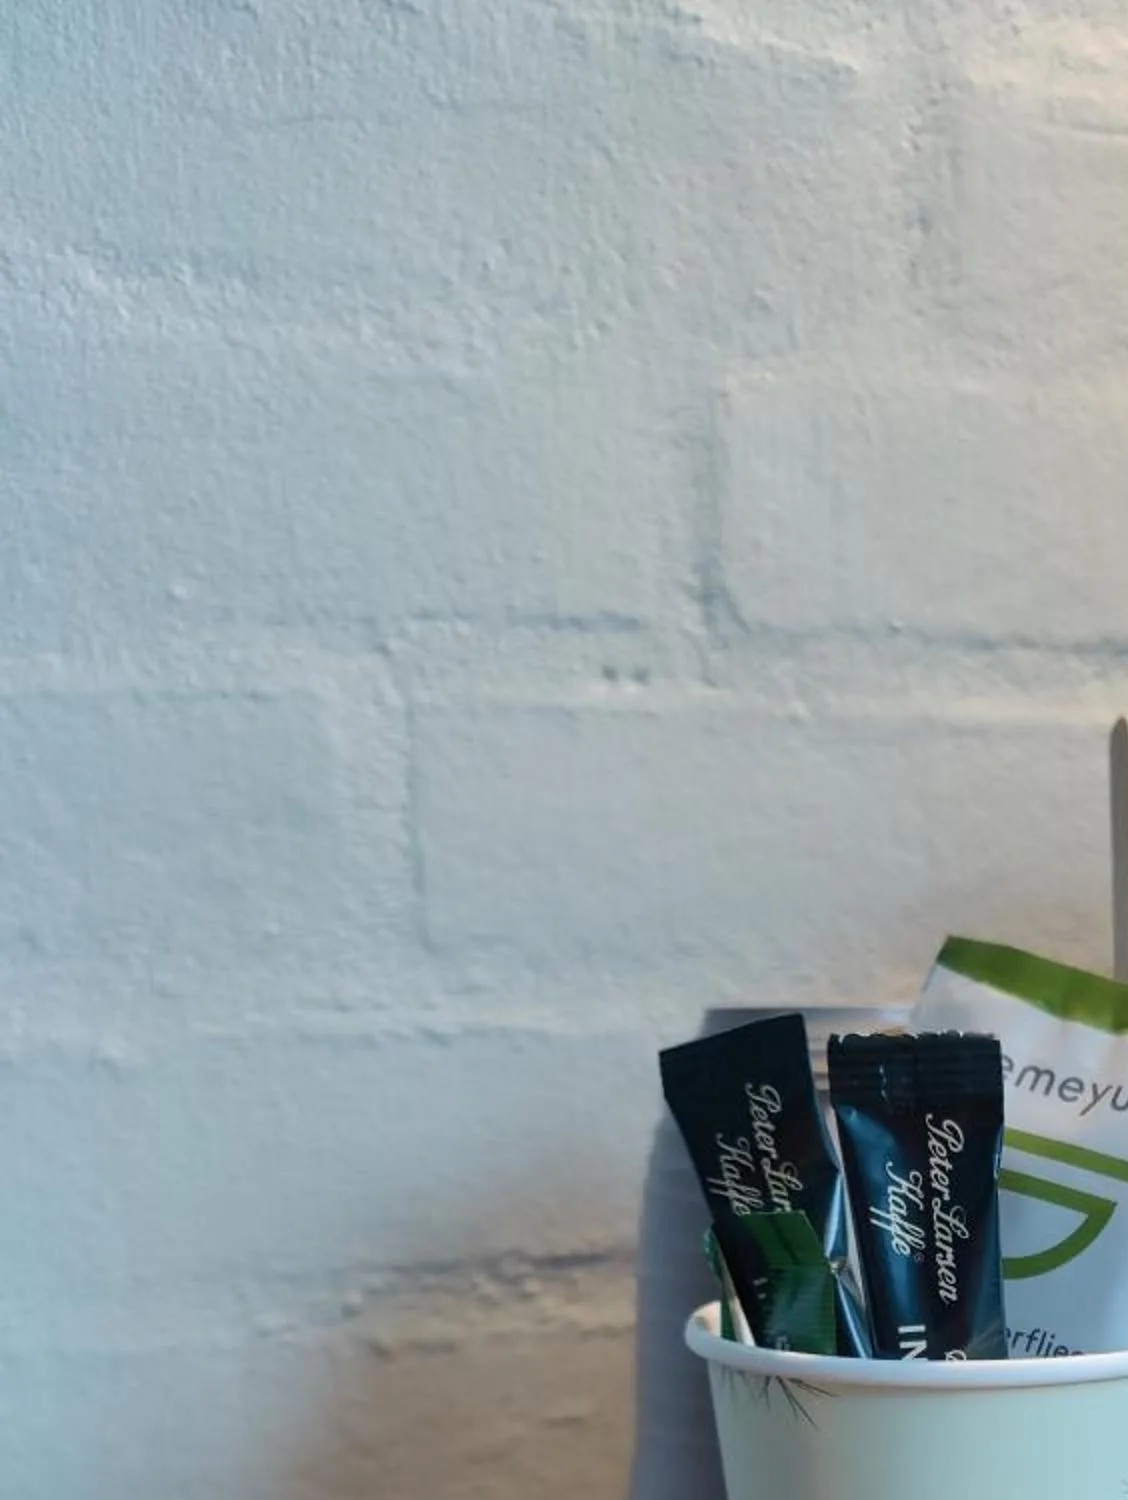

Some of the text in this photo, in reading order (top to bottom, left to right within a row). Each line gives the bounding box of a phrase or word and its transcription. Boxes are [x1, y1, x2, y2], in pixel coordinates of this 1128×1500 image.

[705, 1132, 765, 1217] Kaffe
[744, 1083, 804, 1213] Peter Lar
[925, 1113, 965, 1200] Peter
[868, 1161, 927, 1257] Kaffe
[931, 1199, 970, 1305] Larsen
